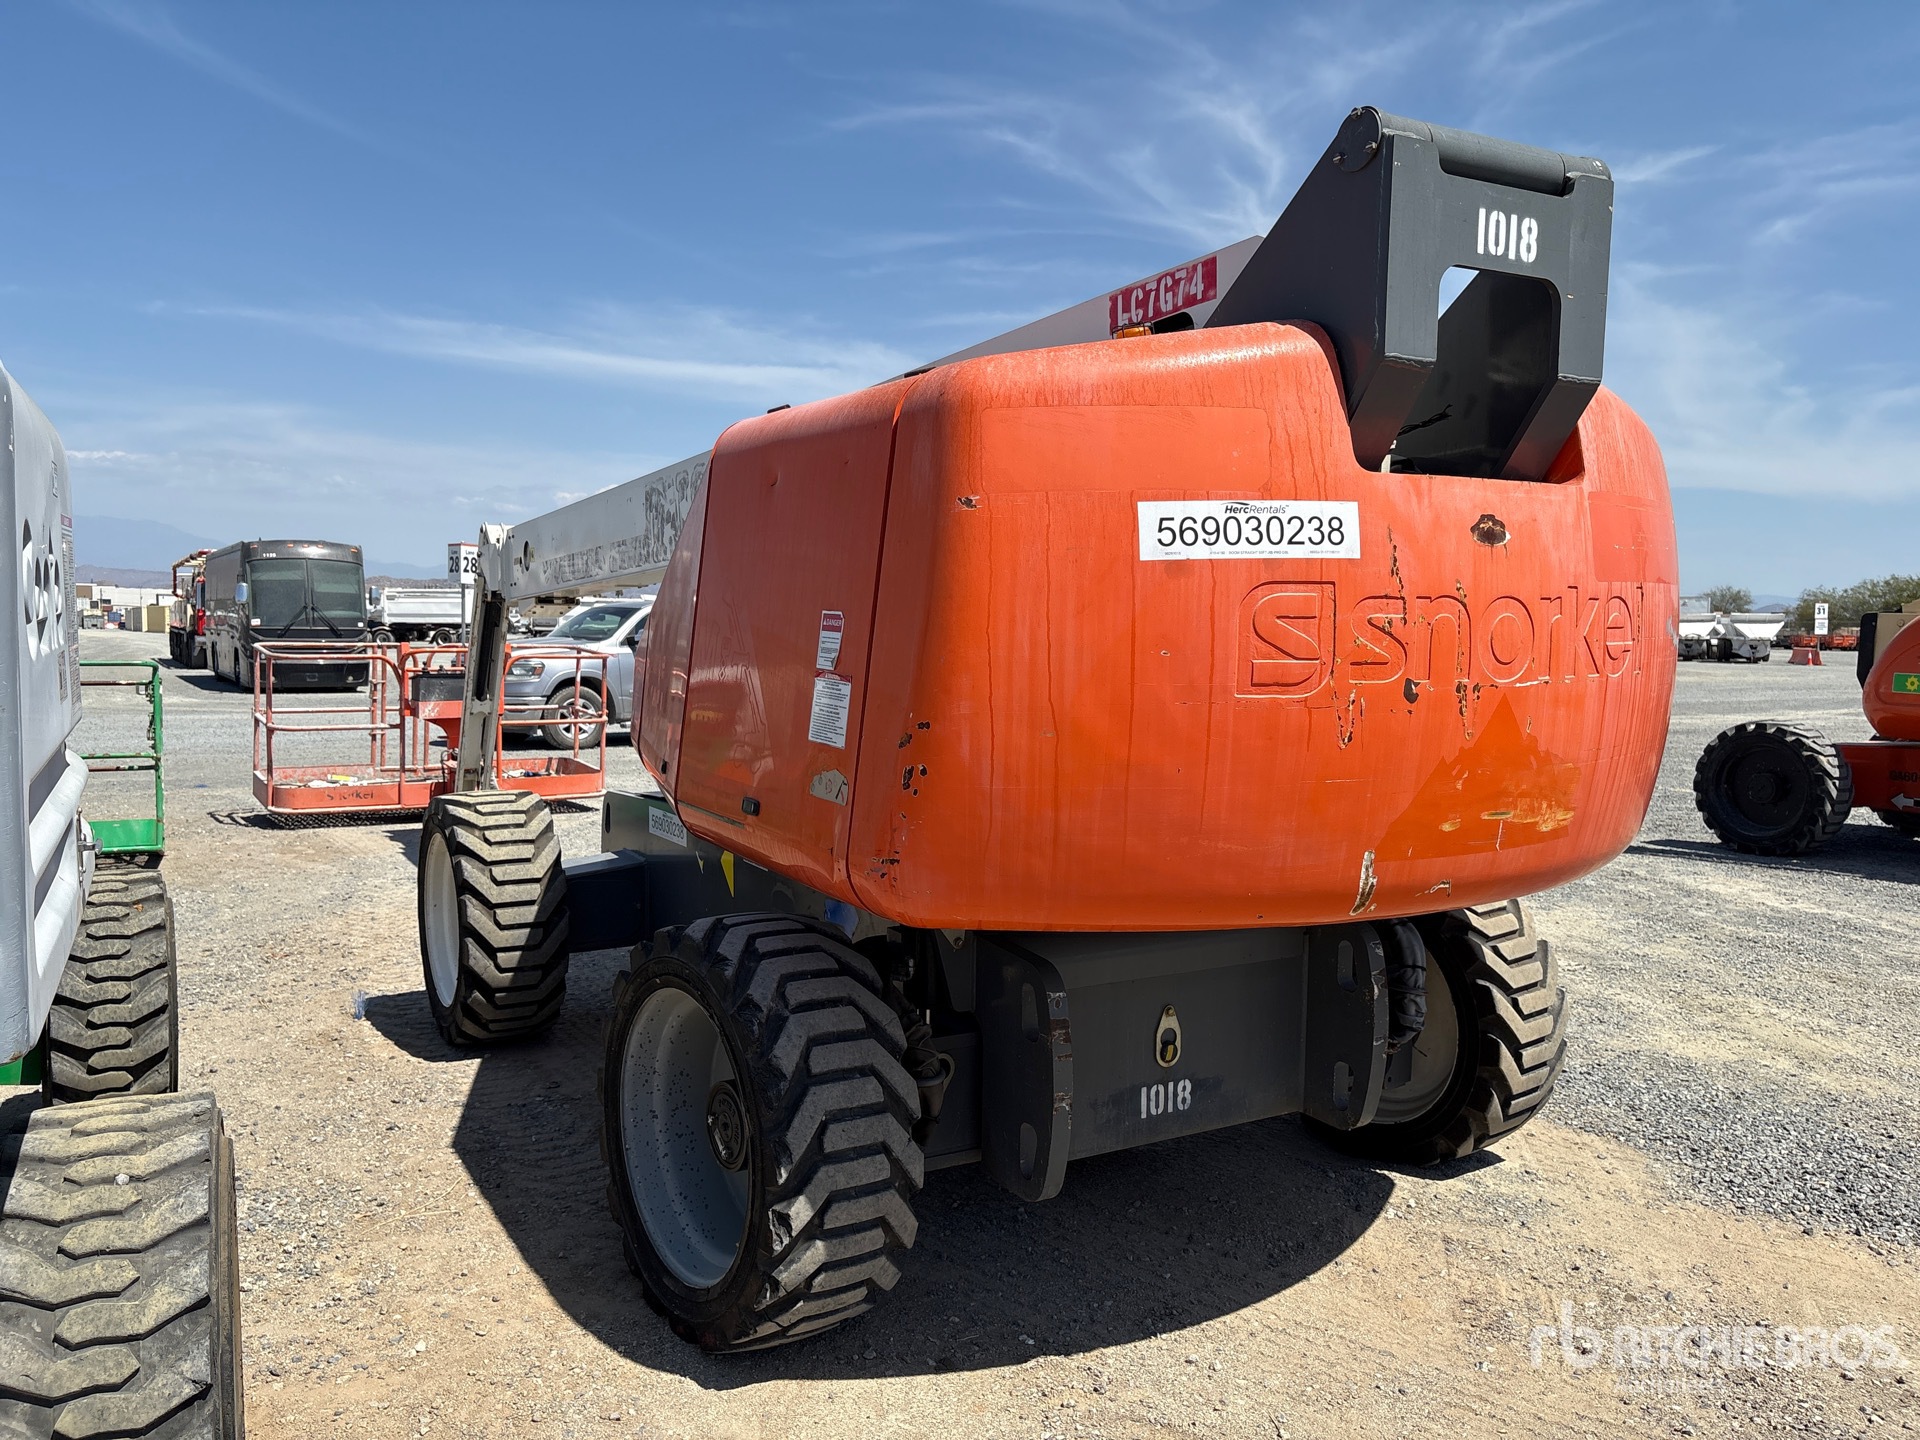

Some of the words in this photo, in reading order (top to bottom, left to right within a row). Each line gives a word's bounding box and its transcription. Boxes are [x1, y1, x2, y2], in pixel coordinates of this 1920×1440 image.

[1476, 207, 1539, 264] 1018
[1117, 262, 1204, 326] LC7G74
[1156, 515, 1345, 548] 569030238
[449, 556, 460, 574] 28
[463, 556, 478, 574] 28
[826, 618, 842, 627] DANGER
[1816, 607, 1826, 615] 31
[1347, 581, 1644, 684] snorkel
[651, 814, 685, 840] 569030238
[1140, 1078, 1192, 1119] 1018
